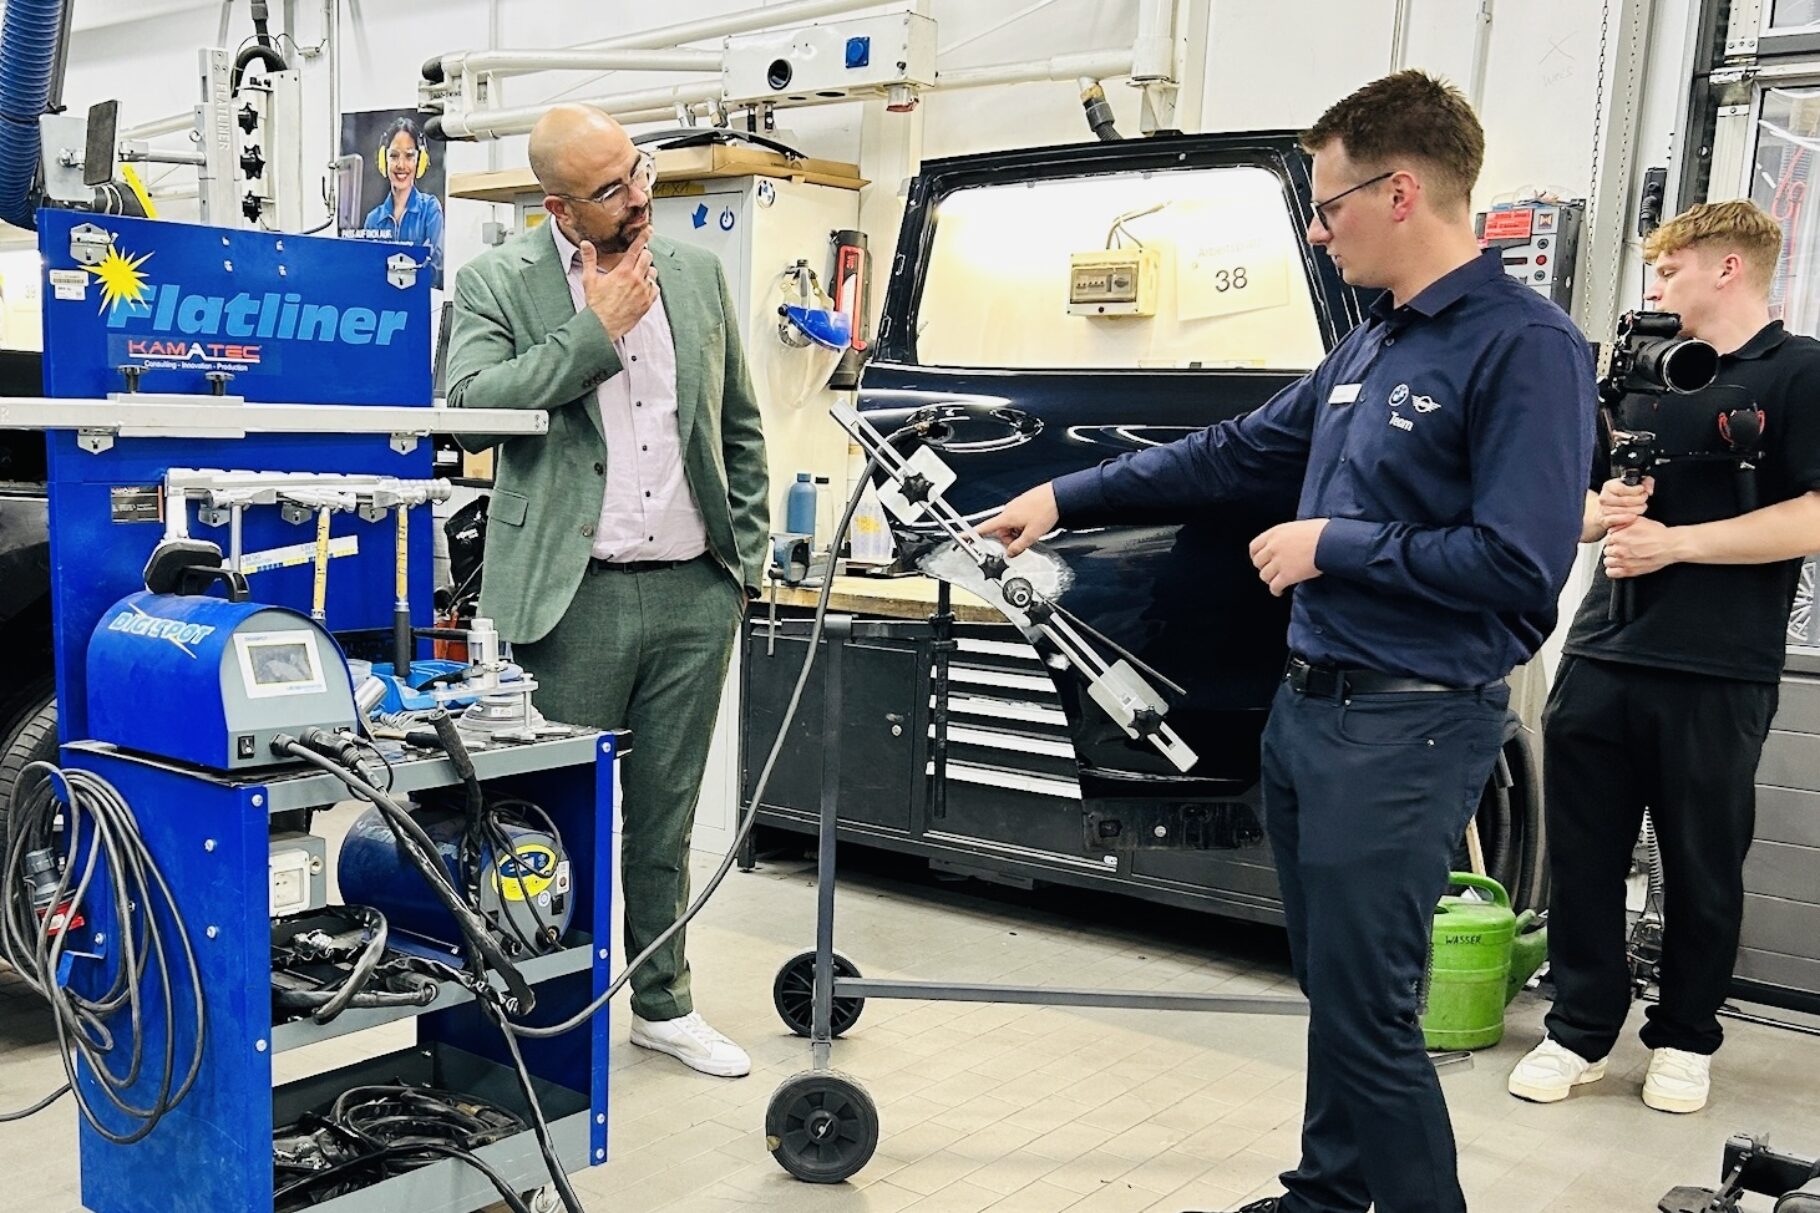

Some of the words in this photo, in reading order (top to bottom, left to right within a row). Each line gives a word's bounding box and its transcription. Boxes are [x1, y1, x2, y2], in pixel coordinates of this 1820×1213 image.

[1215, 266, 1248, 292] 38
[107, 284, 408, 346] Flatliner
[128, 340, 260, 360] KAMATEC
[144, 359, 177, 370] Consulting
[181, 361, 213, 370] Innovation
[216, 363, 249, 372] Production
[1389, 410, 1414, 432] Team
[1445, 934, 1482, 945] WASSER
